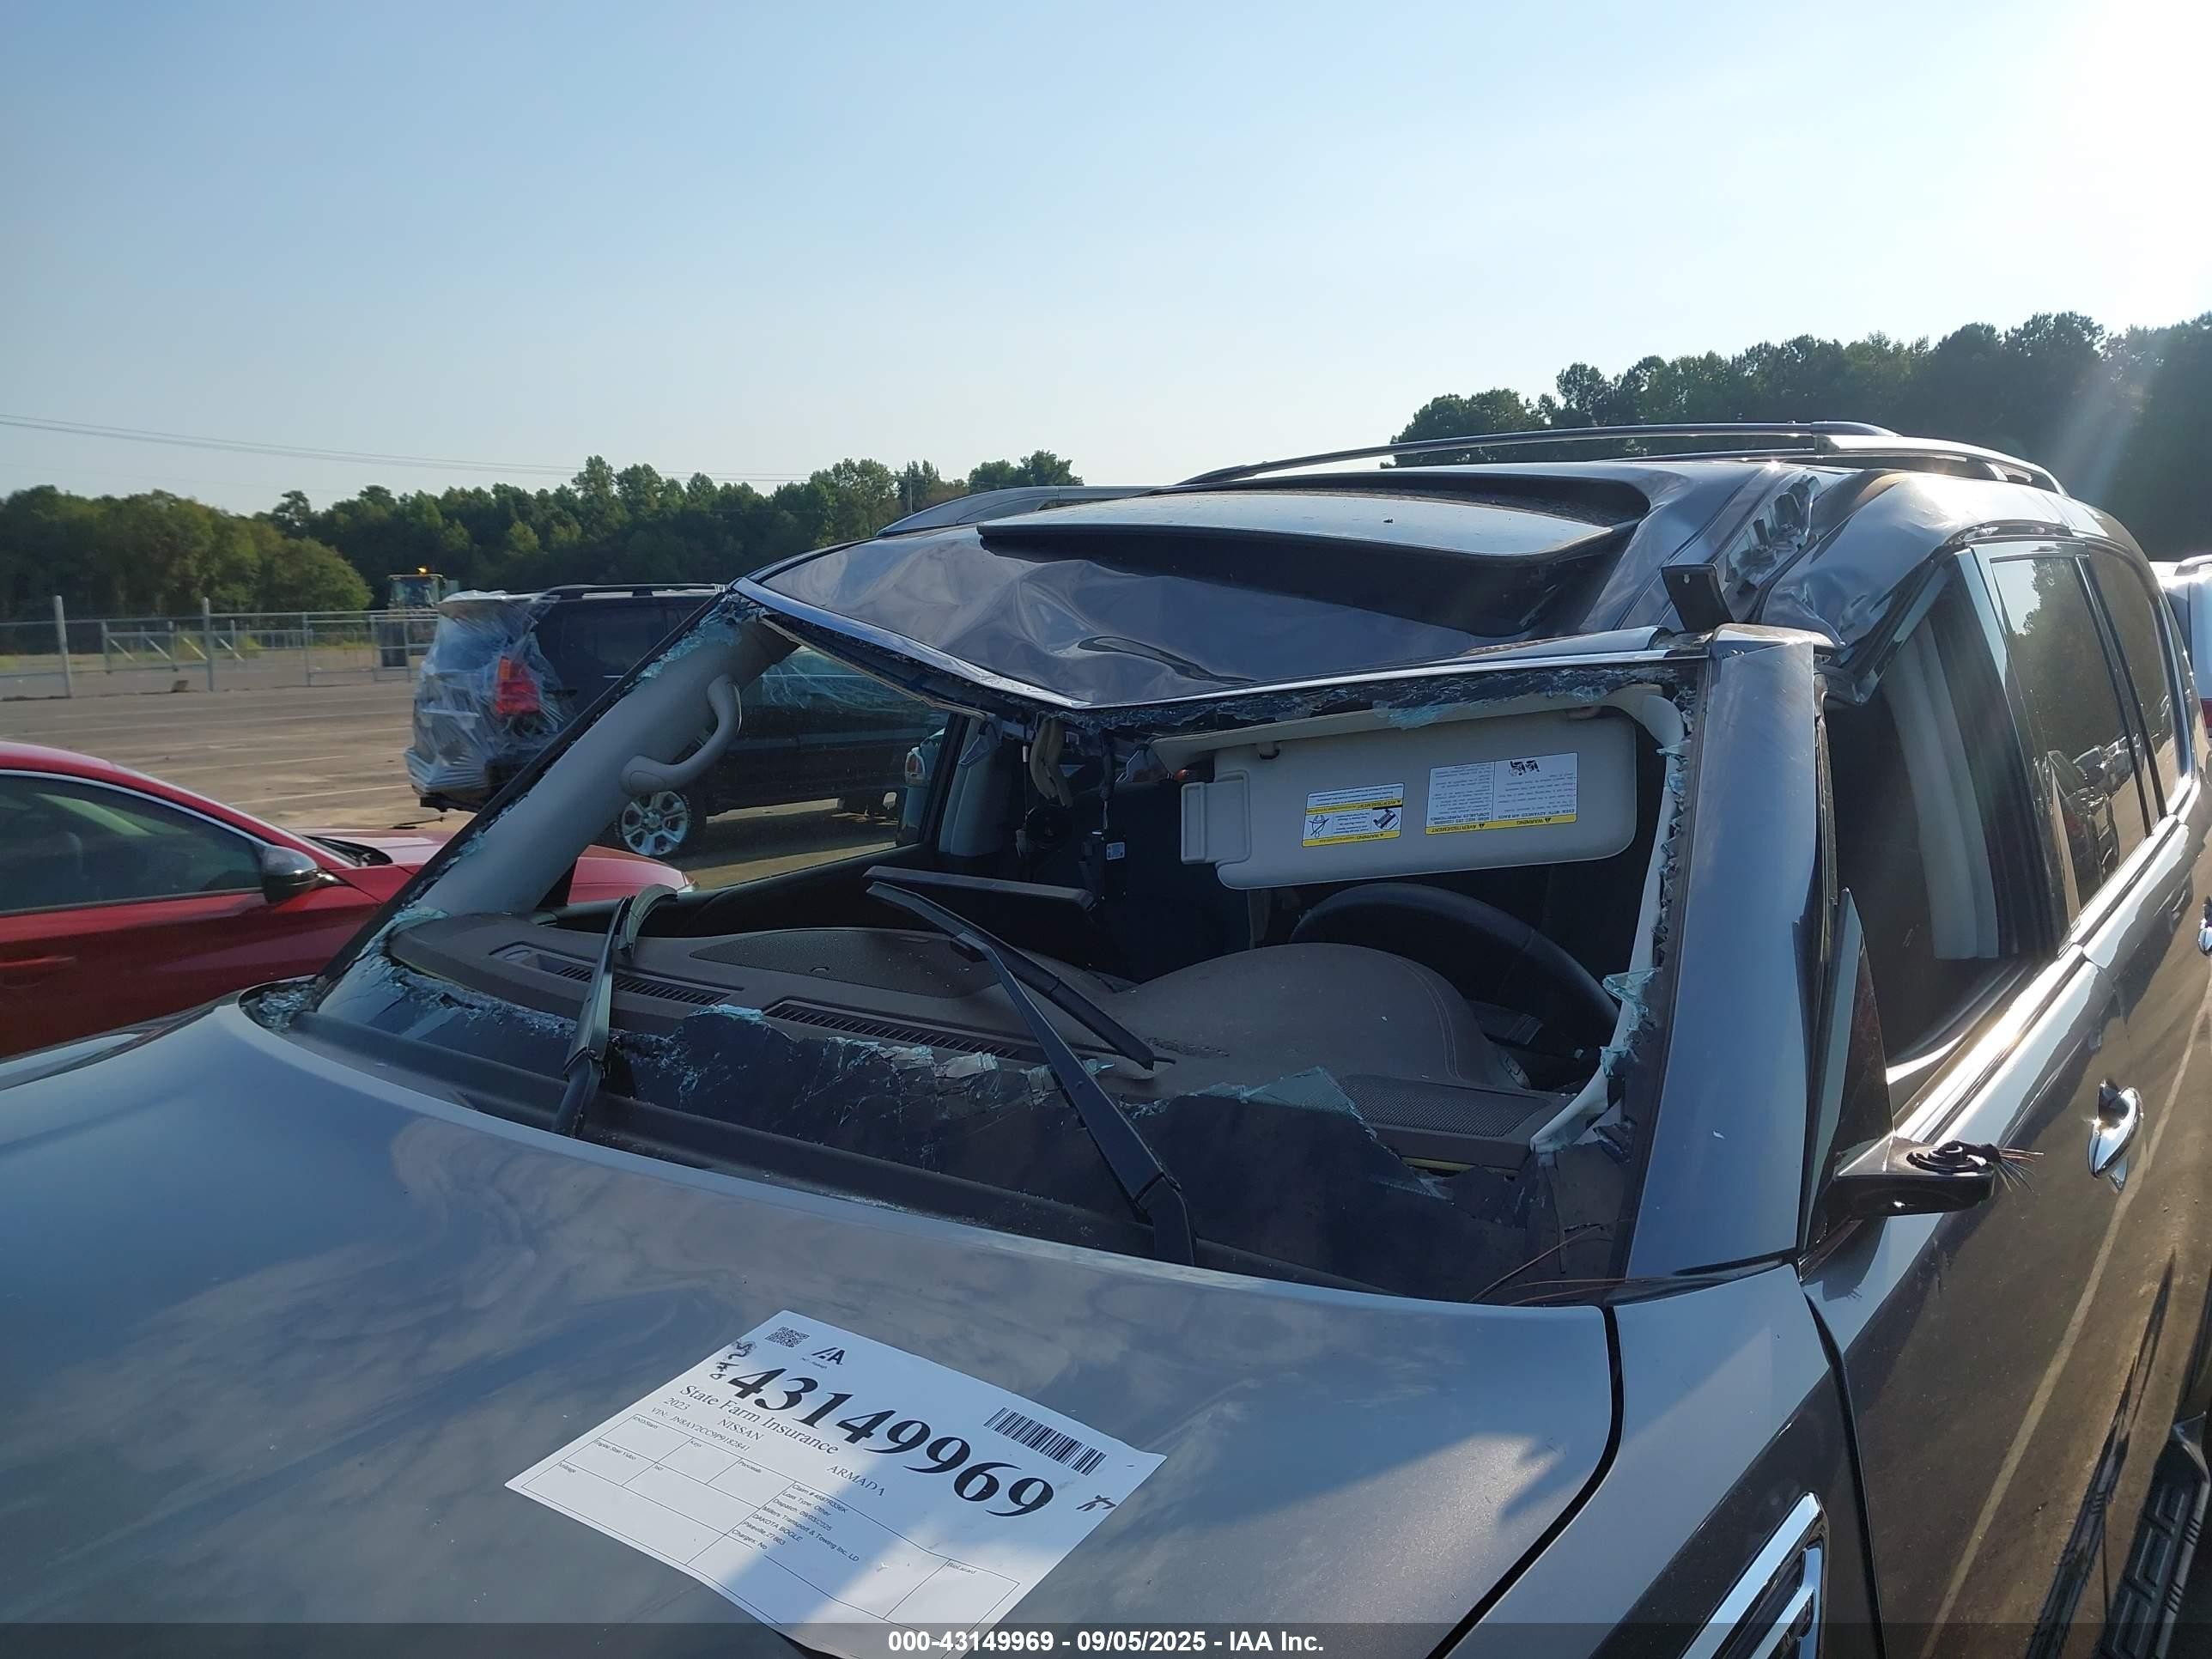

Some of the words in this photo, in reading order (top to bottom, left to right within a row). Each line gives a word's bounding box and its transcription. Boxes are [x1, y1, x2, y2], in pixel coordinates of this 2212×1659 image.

[1431, 824, 1477, 833] AVERTISSEMENT
[680, 1384, 720, 1407] State
[719, 1400, 760, 1423] Farm
[762, 1417, 840, 1455] Insurance
[664, 1396, 690, 1411] 2023
[717, 1418, 765, 1441] NISSAN
[827, 1464, 885, 1497] ARMADA
[727, 1367, 1055, 1517] 43149969
[792, 1484, 811, 1494] Claim
[782, 1491, 796, 1499] Loss
[814, 1504, 832, 1516] Other
[751, 1514, 778, 1528] DAKOTA
[757, 1541, 768, 1550] No
[782, 1515, 810, 1532] Transport
[816, 1533, 837, 1550] Towing
[848, 1552, 859, 1562] LD
